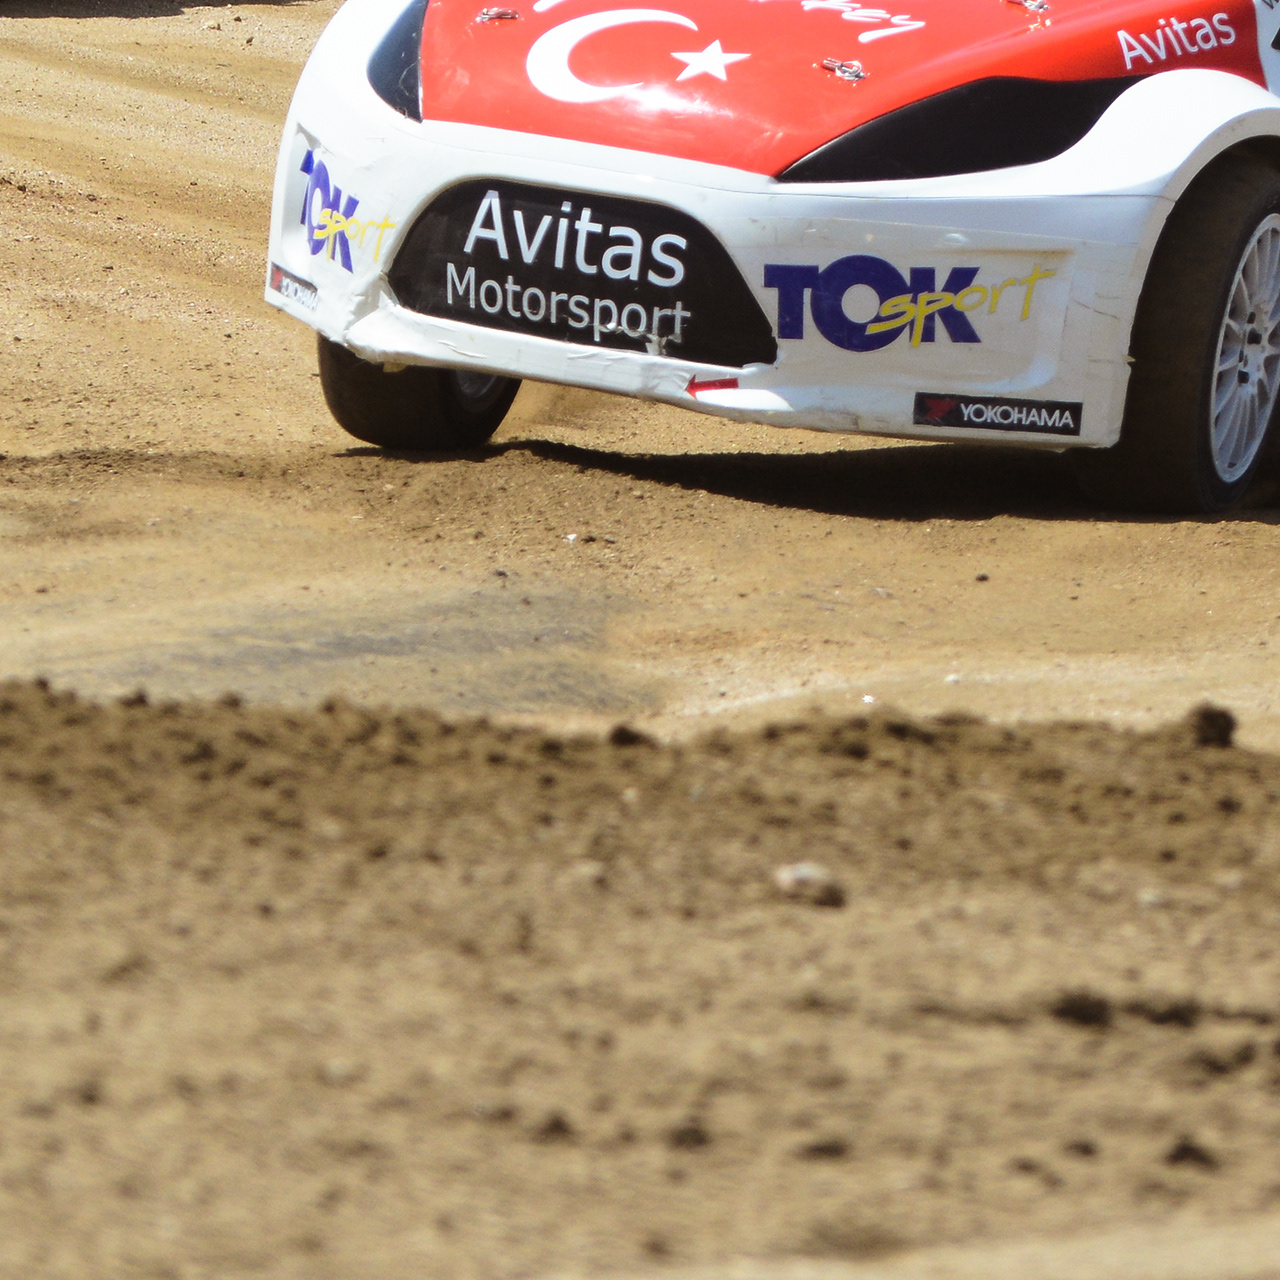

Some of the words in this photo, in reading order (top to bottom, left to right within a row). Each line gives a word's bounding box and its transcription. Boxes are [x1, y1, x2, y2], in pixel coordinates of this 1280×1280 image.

[1116, 11, 1237, 70] Avitas
[300, 148, 360, 274] TOK
[312, 207, 397, 263] sport
[463, 189, 688, 287] Avitas
[445, 260, 692, 343] Motorsport
[763, 254, 982, 353] TOK
[864, 265, 1056, 348] sport
[960, 401, 1075, 429] YOKOHAMA
